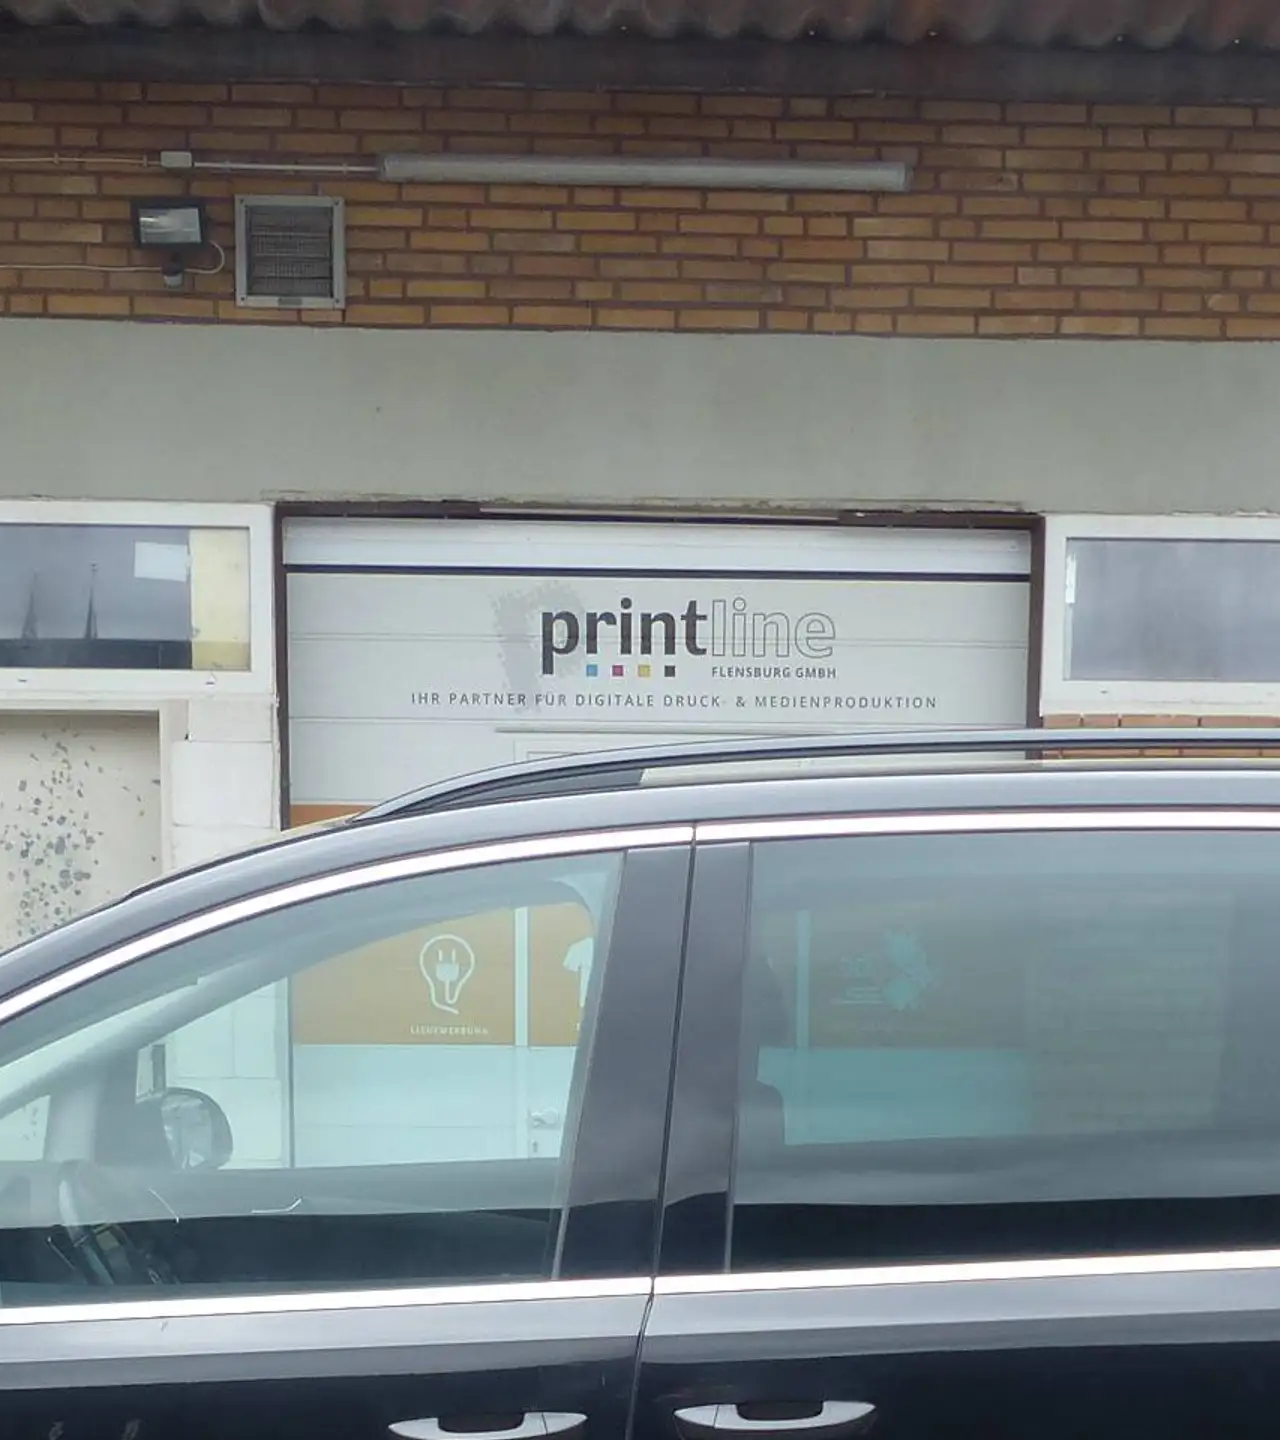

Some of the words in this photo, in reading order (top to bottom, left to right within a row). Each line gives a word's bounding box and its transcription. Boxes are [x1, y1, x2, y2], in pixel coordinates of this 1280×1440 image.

[541, 596, 836, 675] printline
[711, 666, 791, 679] FLENSBURG
[795, 666, 837, 679] GMBH
[411, 692, 440, 706] IHR
[449, 692, 527, 707] PARTNER
[535, 691, 567, 707] FÜR
[575, 693, 654, 707] DIGITALE
[735, 695, 746, 708] &
[755, 695, 936, 709] MEDIENPRODUKTION
